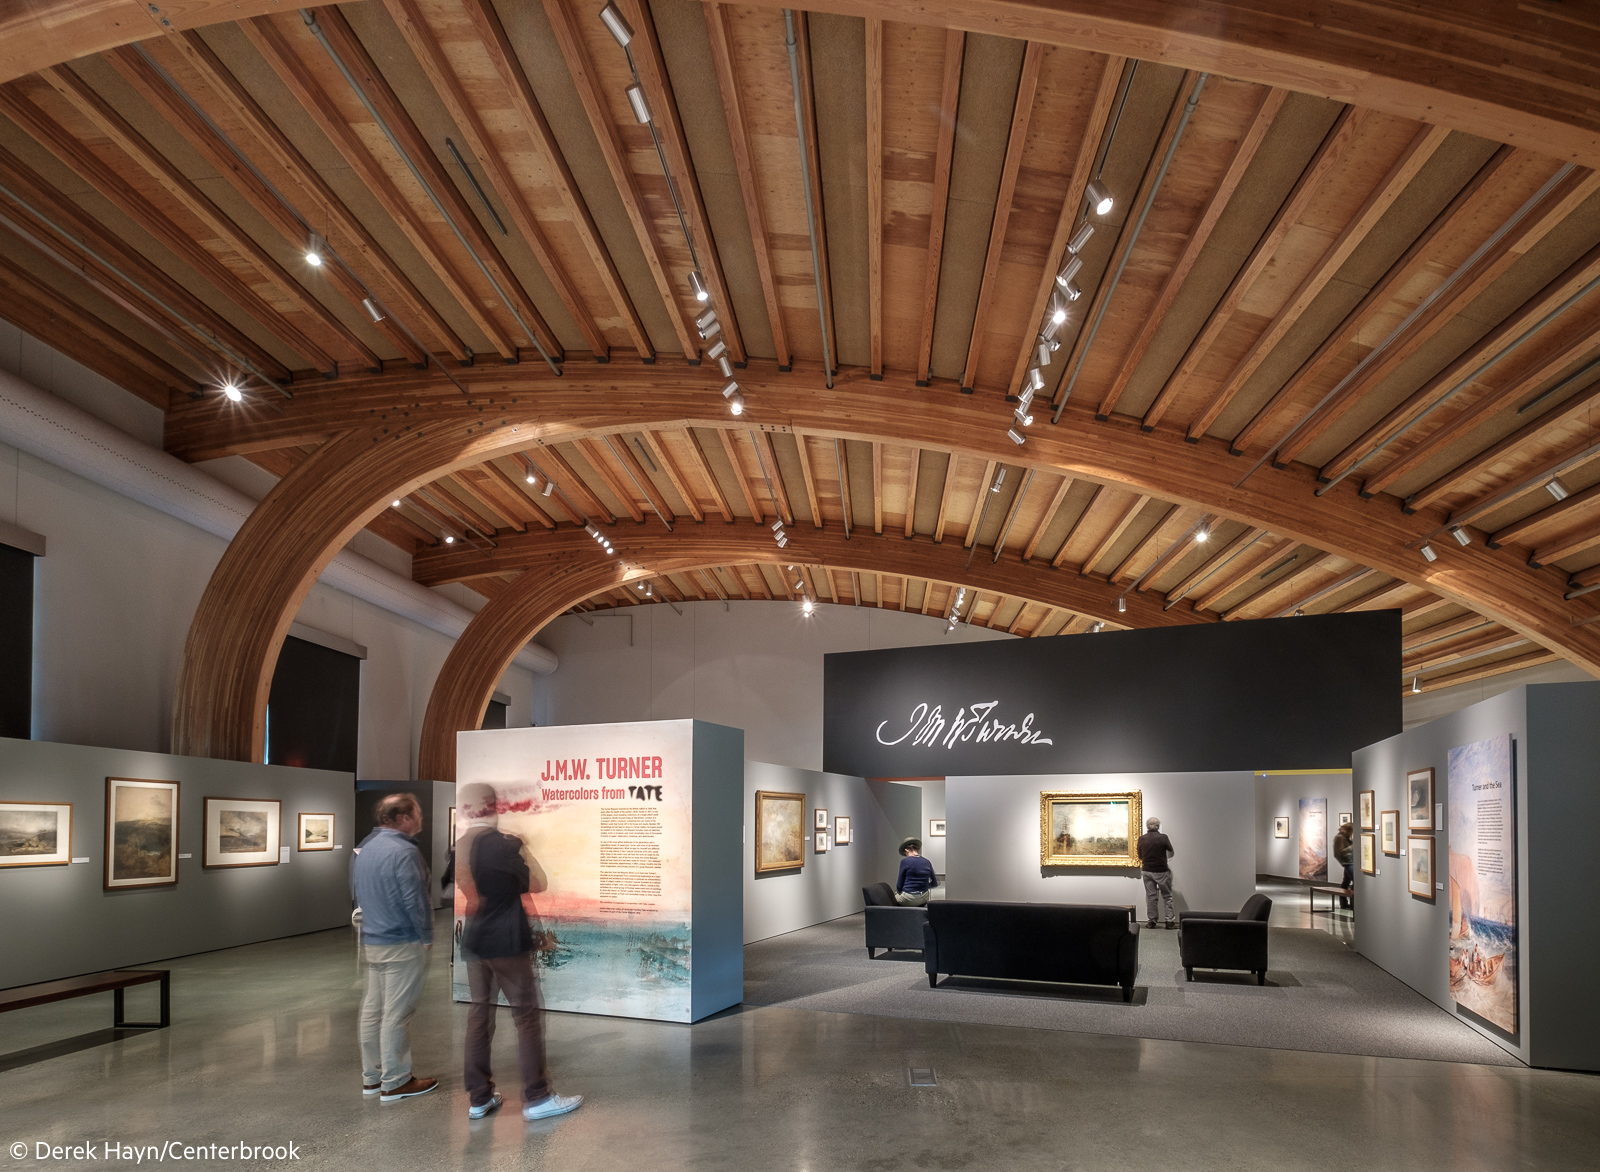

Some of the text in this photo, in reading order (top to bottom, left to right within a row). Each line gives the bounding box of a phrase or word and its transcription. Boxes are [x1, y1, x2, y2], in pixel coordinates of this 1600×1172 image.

[541, 756, 663, 781] J.M.W. TURNER
[541, 785, 663, 801] Watercolors from TATE
